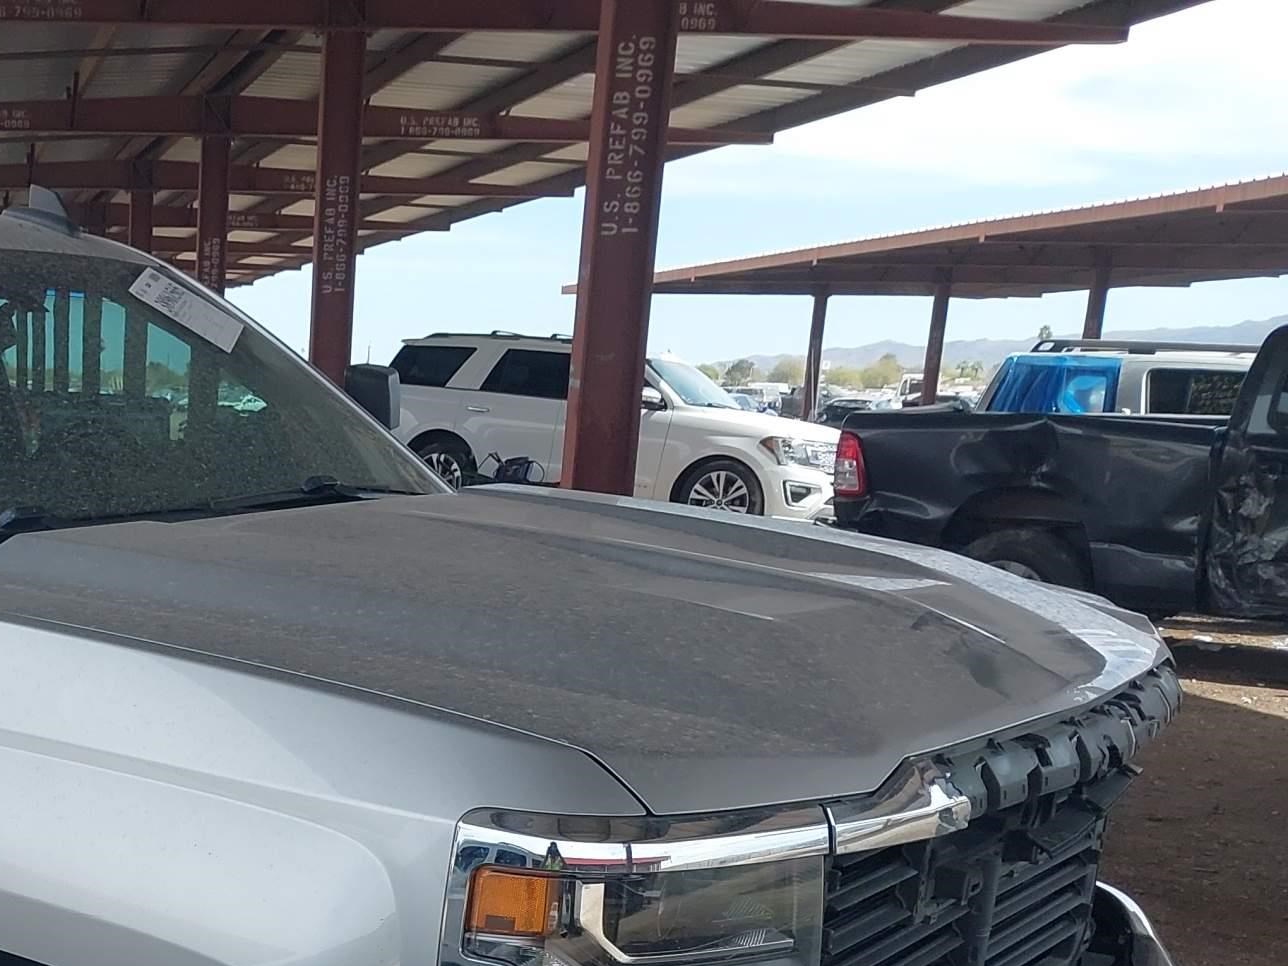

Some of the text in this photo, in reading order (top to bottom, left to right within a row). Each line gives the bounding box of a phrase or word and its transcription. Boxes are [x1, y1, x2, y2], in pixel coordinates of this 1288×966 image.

[601, 34, 638, 236] U.S. PREFAB INC.
[622, 36, 656, 233] 1-866-799-0969
